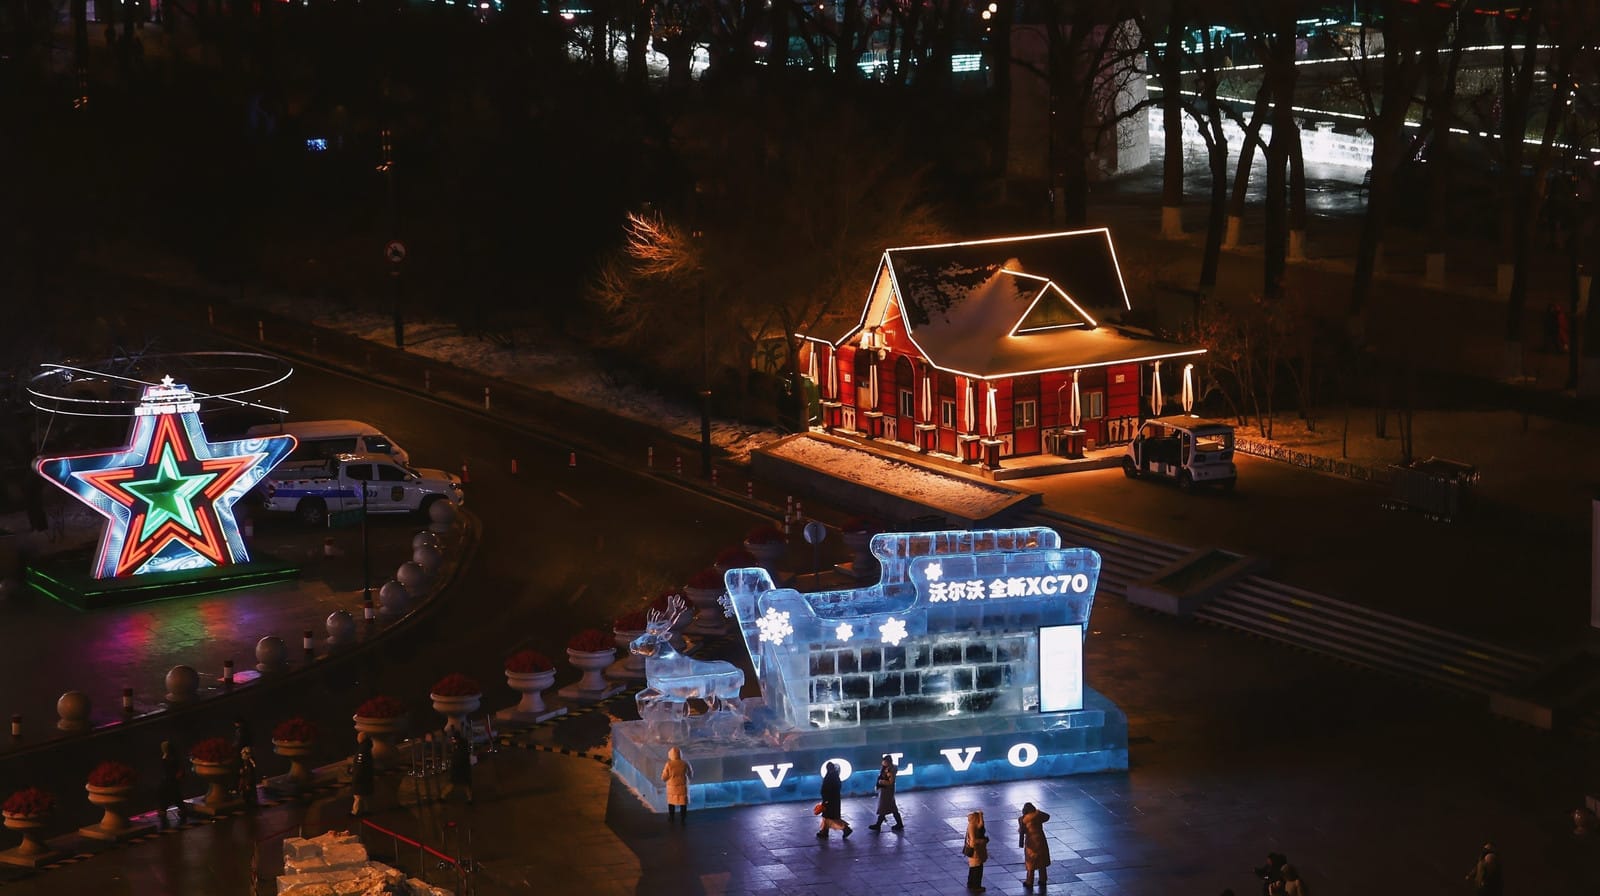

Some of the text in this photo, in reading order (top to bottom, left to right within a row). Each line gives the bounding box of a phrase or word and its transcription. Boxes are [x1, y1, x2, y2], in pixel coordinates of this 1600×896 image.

[928, 573, 1089, 603] 沃尔沃 全新XC70
